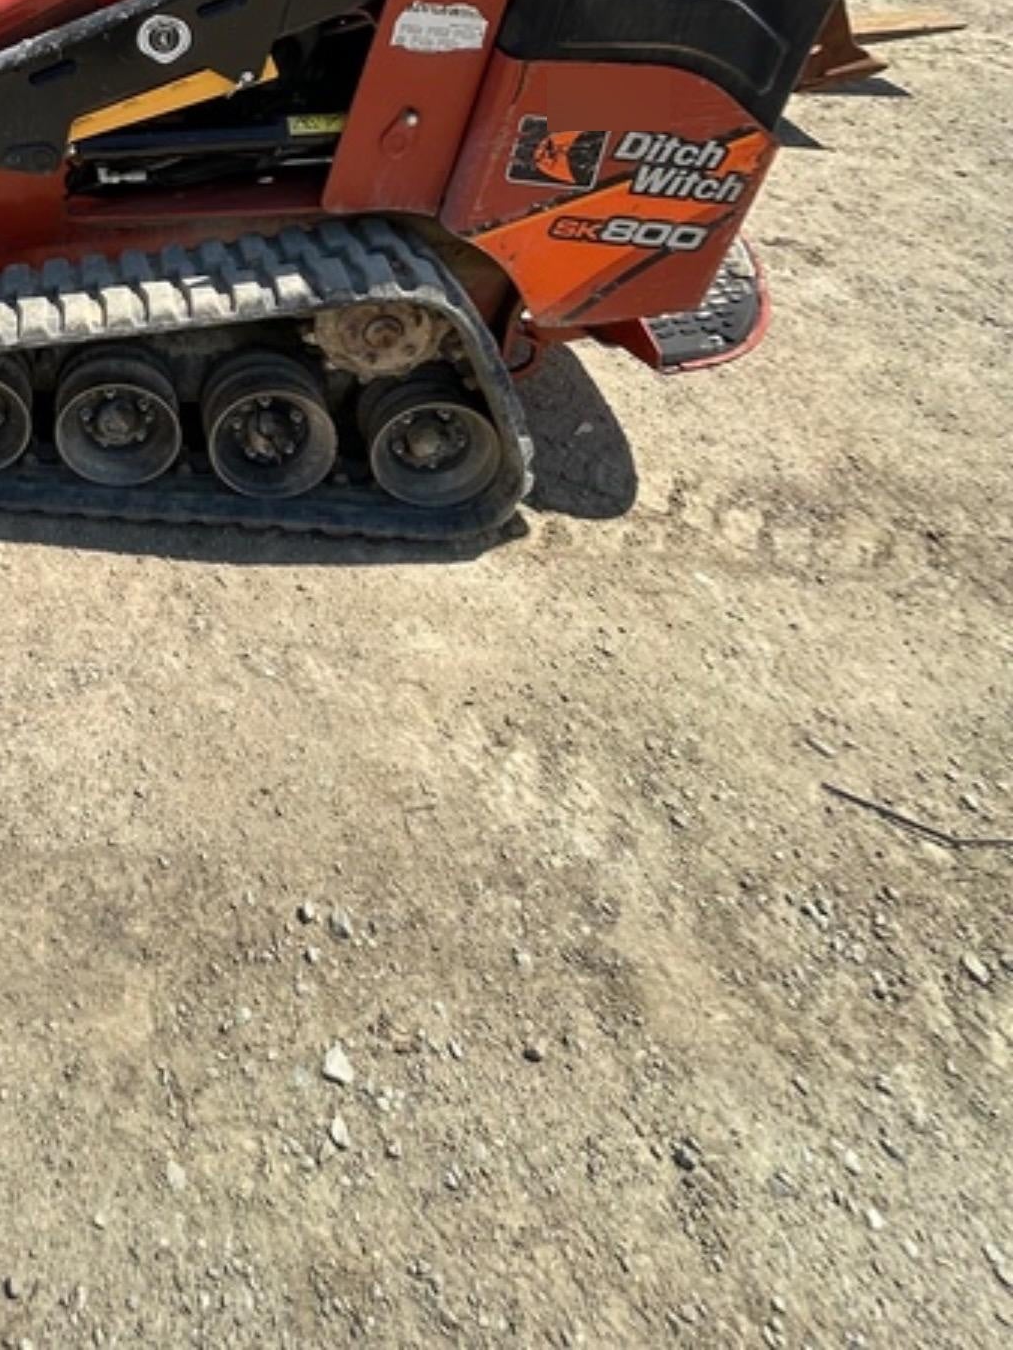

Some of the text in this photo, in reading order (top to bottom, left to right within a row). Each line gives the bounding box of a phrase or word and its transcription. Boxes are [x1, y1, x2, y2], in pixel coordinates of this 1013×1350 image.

[614, 130, 727, 170] Ditch
[632, 166, 744, 202] Witch
[550, 218, 709, 251] SK800
